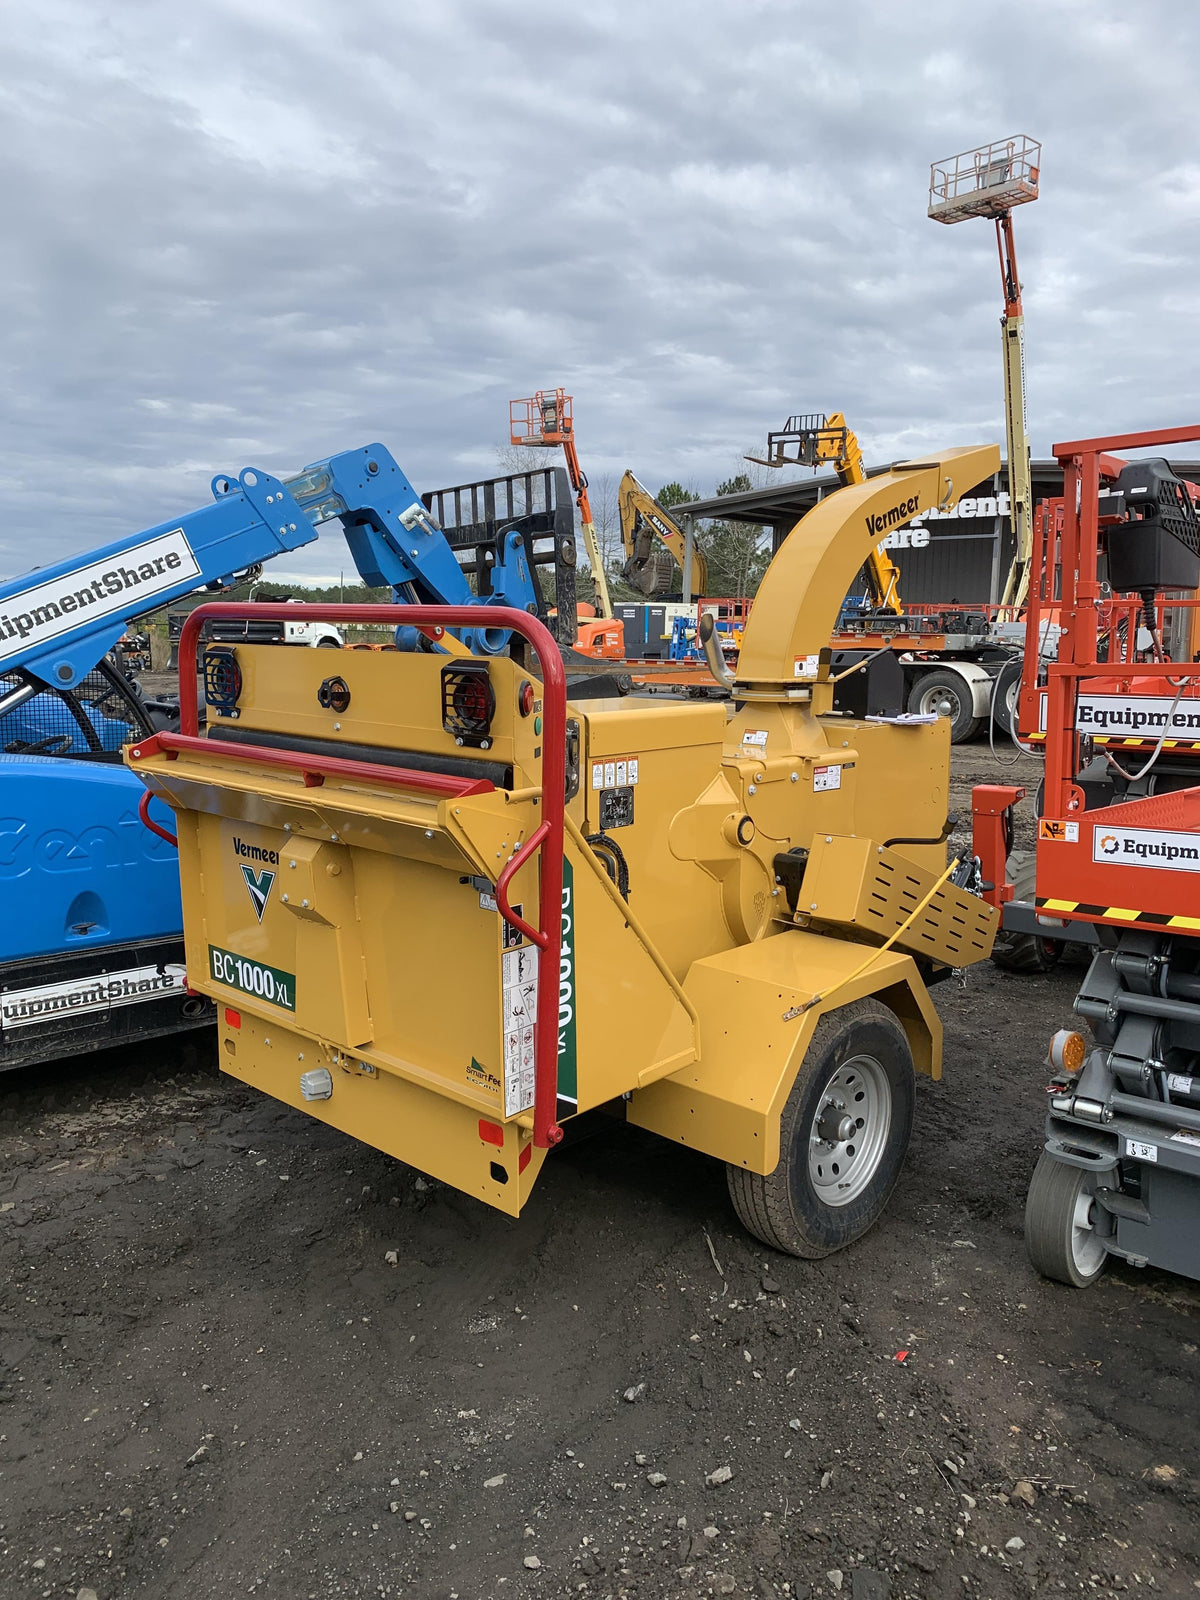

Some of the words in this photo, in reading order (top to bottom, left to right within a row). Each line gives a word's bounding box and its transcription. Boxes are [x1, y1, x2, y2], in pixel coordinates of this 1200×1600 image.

[651, 516, 669, 535] SANY
[865, 495, 919, 537] Vermeer
[1078, 705, 1200, 728] Equipmen
[1123, 838, 1199, 860] Equipm
